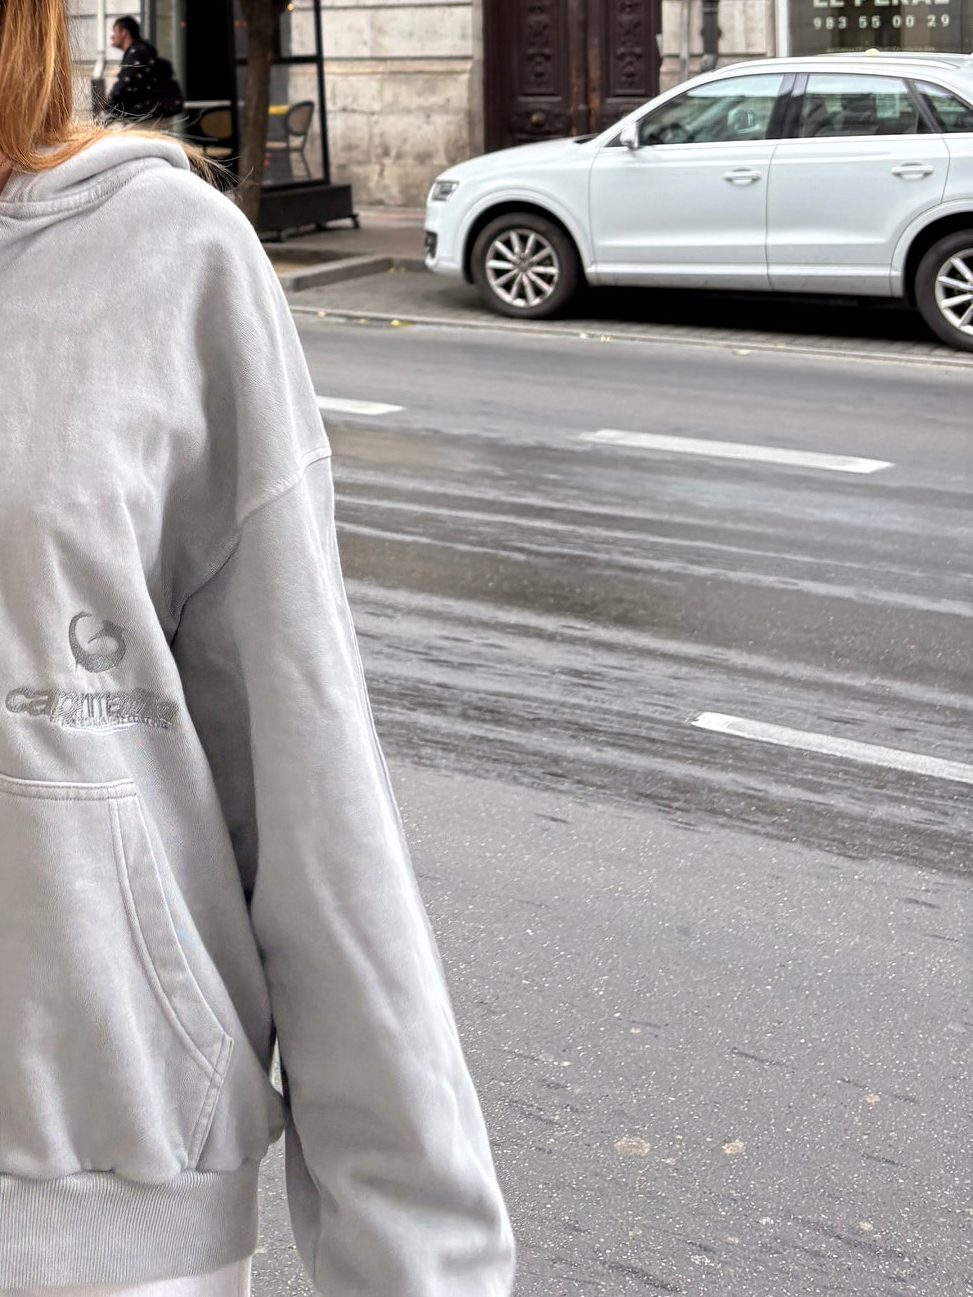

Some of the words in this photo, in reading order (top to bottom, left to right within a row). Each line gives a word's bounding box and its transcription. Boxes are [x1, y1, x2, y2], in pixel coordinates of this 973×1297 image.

[813, 16, 848, 30] 983
[859, 15, 881, 29] 55
[892, 14, 915, 28] 00
[927, 13, 950, 28] 29
